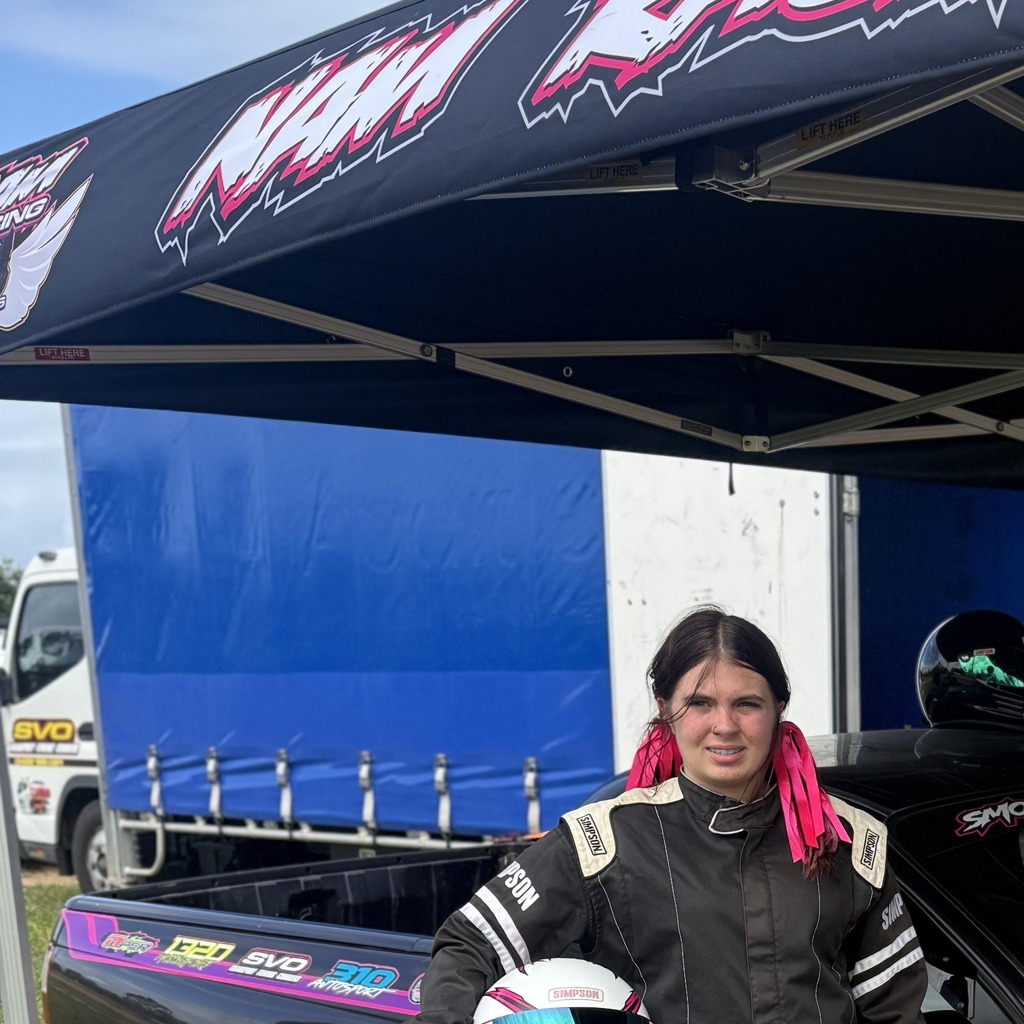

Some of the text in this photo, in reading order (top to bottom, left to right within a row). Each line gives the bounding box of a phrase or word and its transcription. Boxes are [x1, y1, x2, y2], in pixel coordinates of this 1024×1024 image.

[801, 111, 860, 141] LIFT HERE
[589, 164, 638, 180] LIFT HERE
[39, 348, 85, 357] LIFT HERE
[13, 720, 75, 741] SVO
[580, 816, 602, 855] SIMPSON
[863, 832, 877, 867] SIMPSON
[497, 860, 541, 912] PSON
[881, 892, 904, 931] SIMP
[164, 935, 236, 961] 1320
[241, 951, 309, 972] SVO
[307, 978, 397, 999] AUTOSPORT
[323, 962, 396, 989] 310
[552, 988, 601, 1000] SIMPSON
